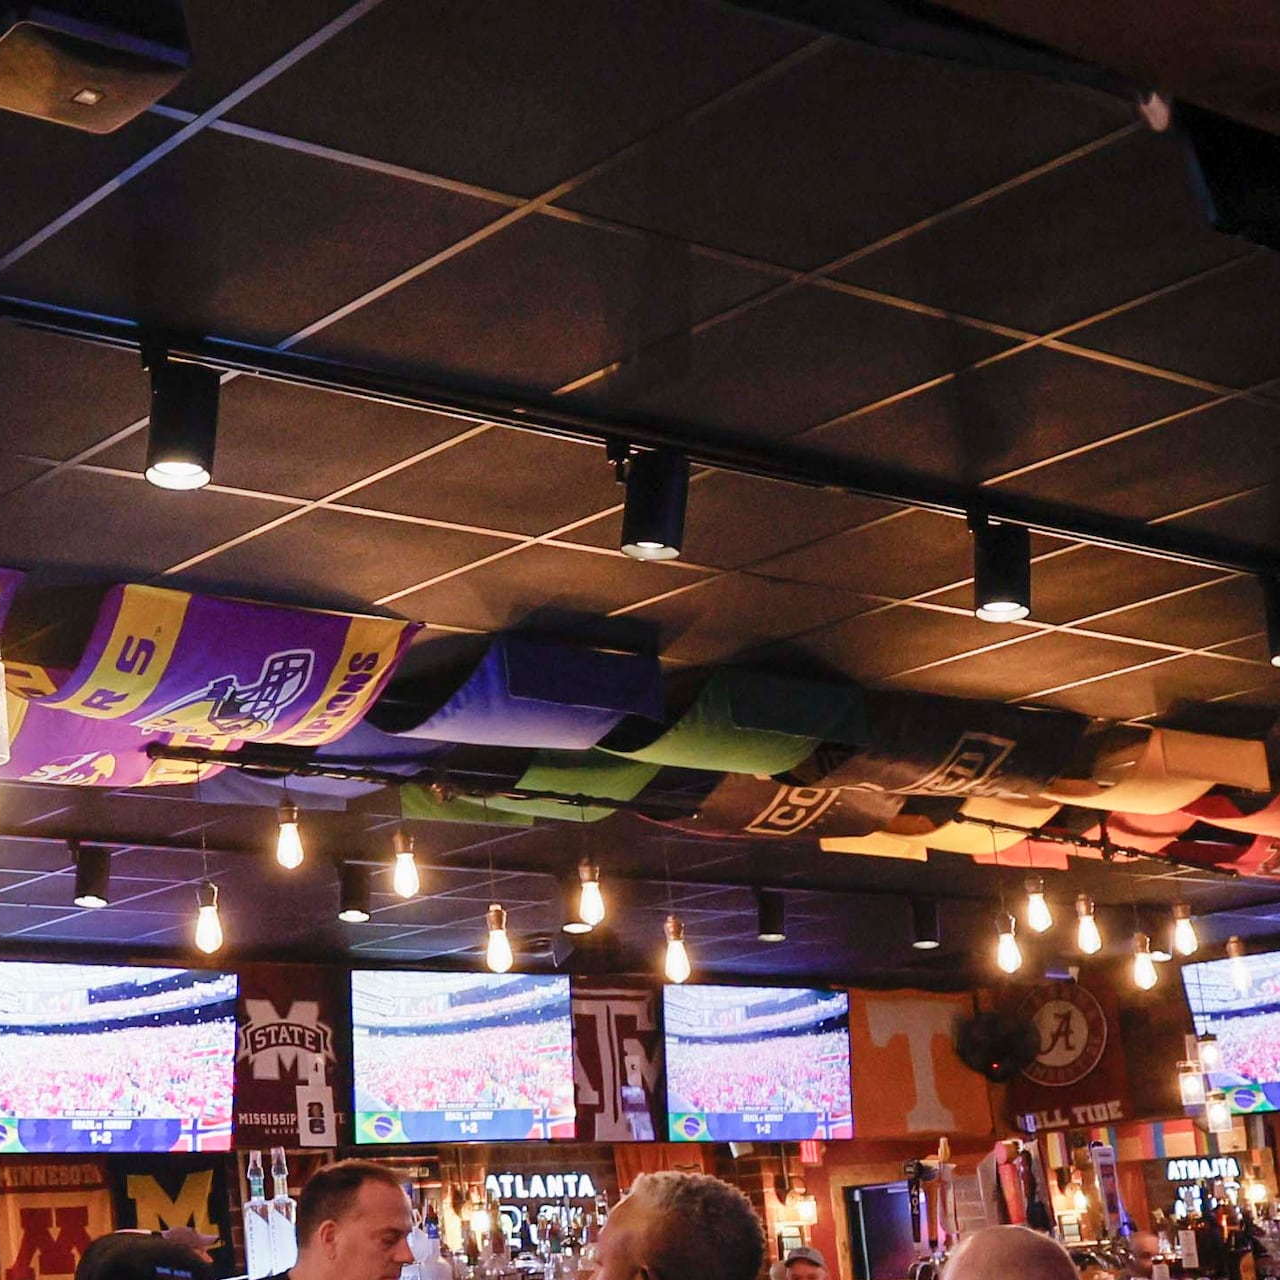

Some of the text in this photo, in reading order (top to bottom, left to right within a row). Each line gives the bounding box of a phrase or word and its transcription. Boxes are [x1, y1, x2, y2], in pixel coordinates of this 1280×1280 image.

[255, 1024, 317, 1051] STATE
[1073, 1100, 1124, 1125] TIDE
[485, 1174, 596, 1199] ATLANTA
